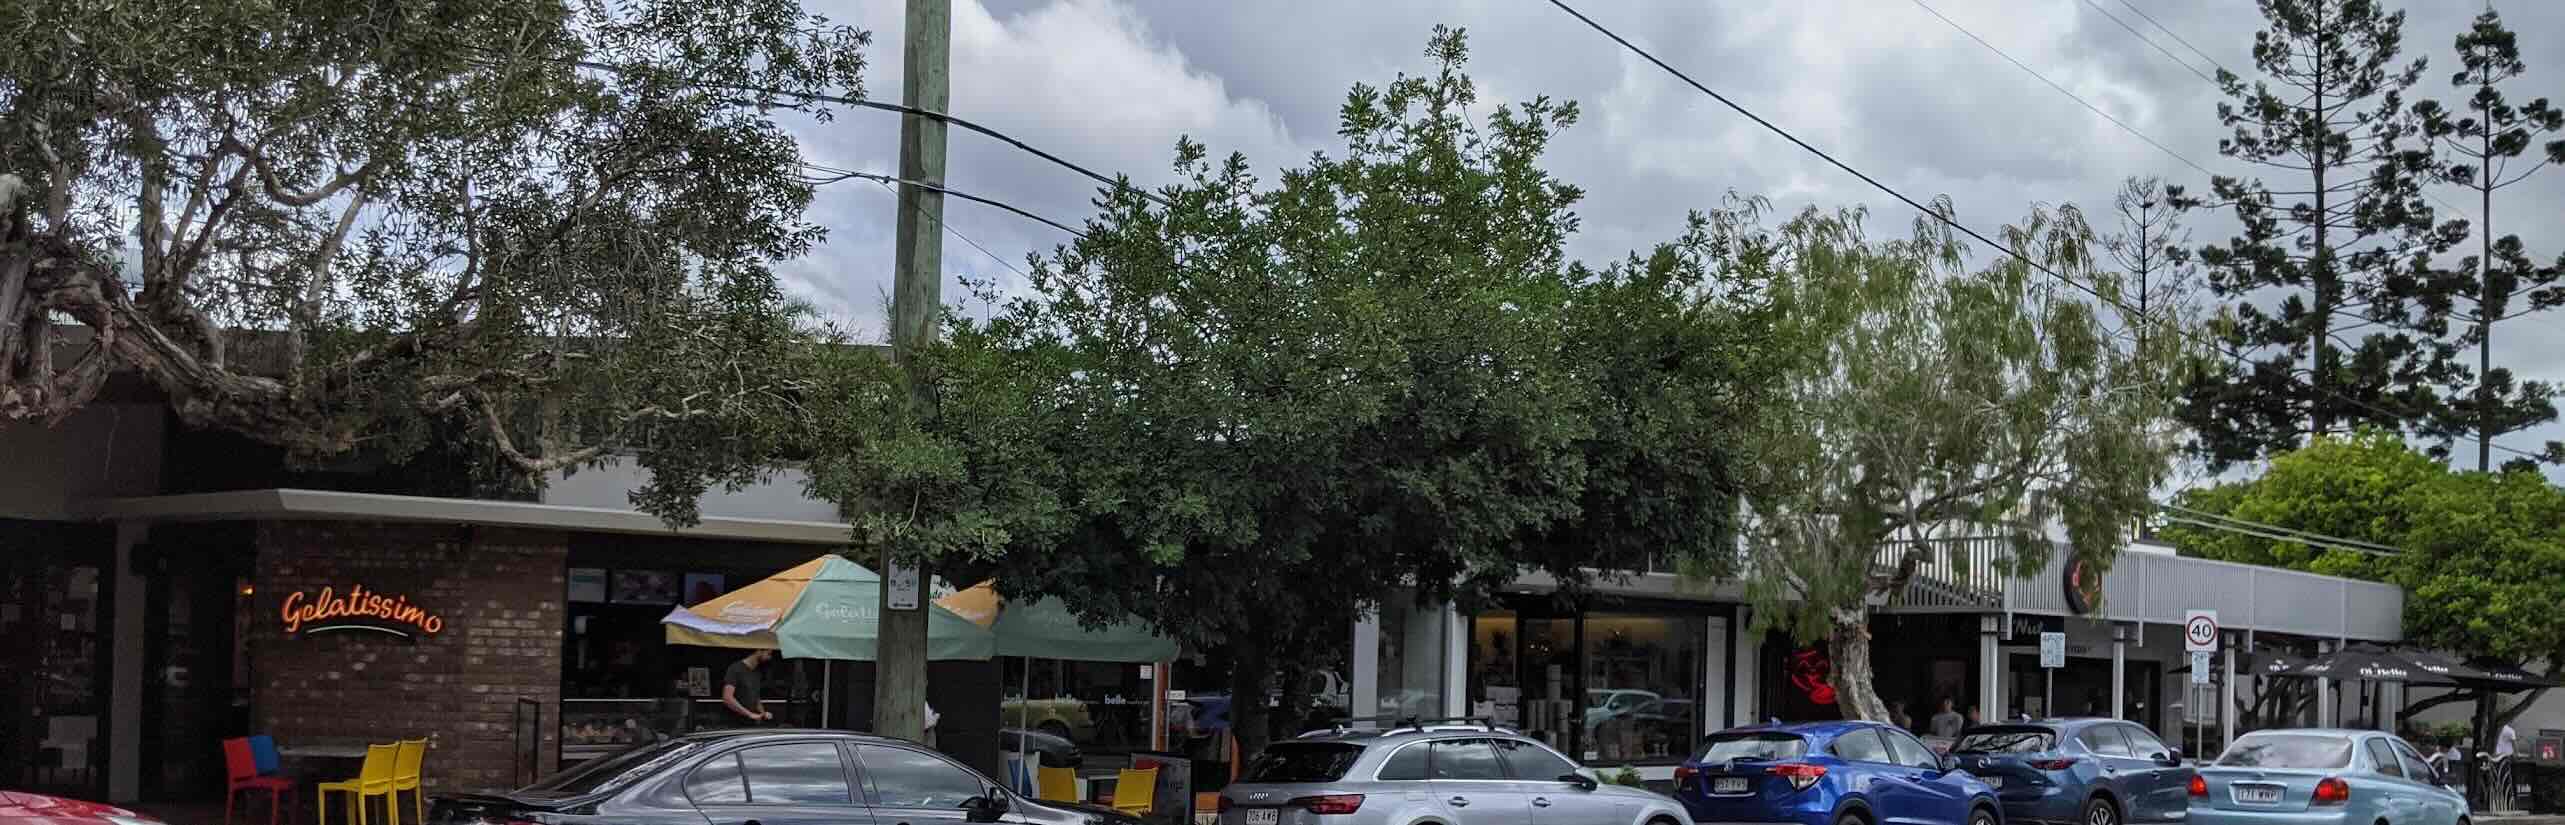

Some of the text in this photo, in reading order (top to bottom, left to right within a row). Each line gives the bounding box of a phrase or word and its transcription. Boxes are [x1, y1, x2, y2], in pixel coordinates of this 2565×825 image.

[281, 584, 443, 633] Gelatissimo
[2191, 623, 2212, 638] 40
[1104, 693, 1127, 705] belle
